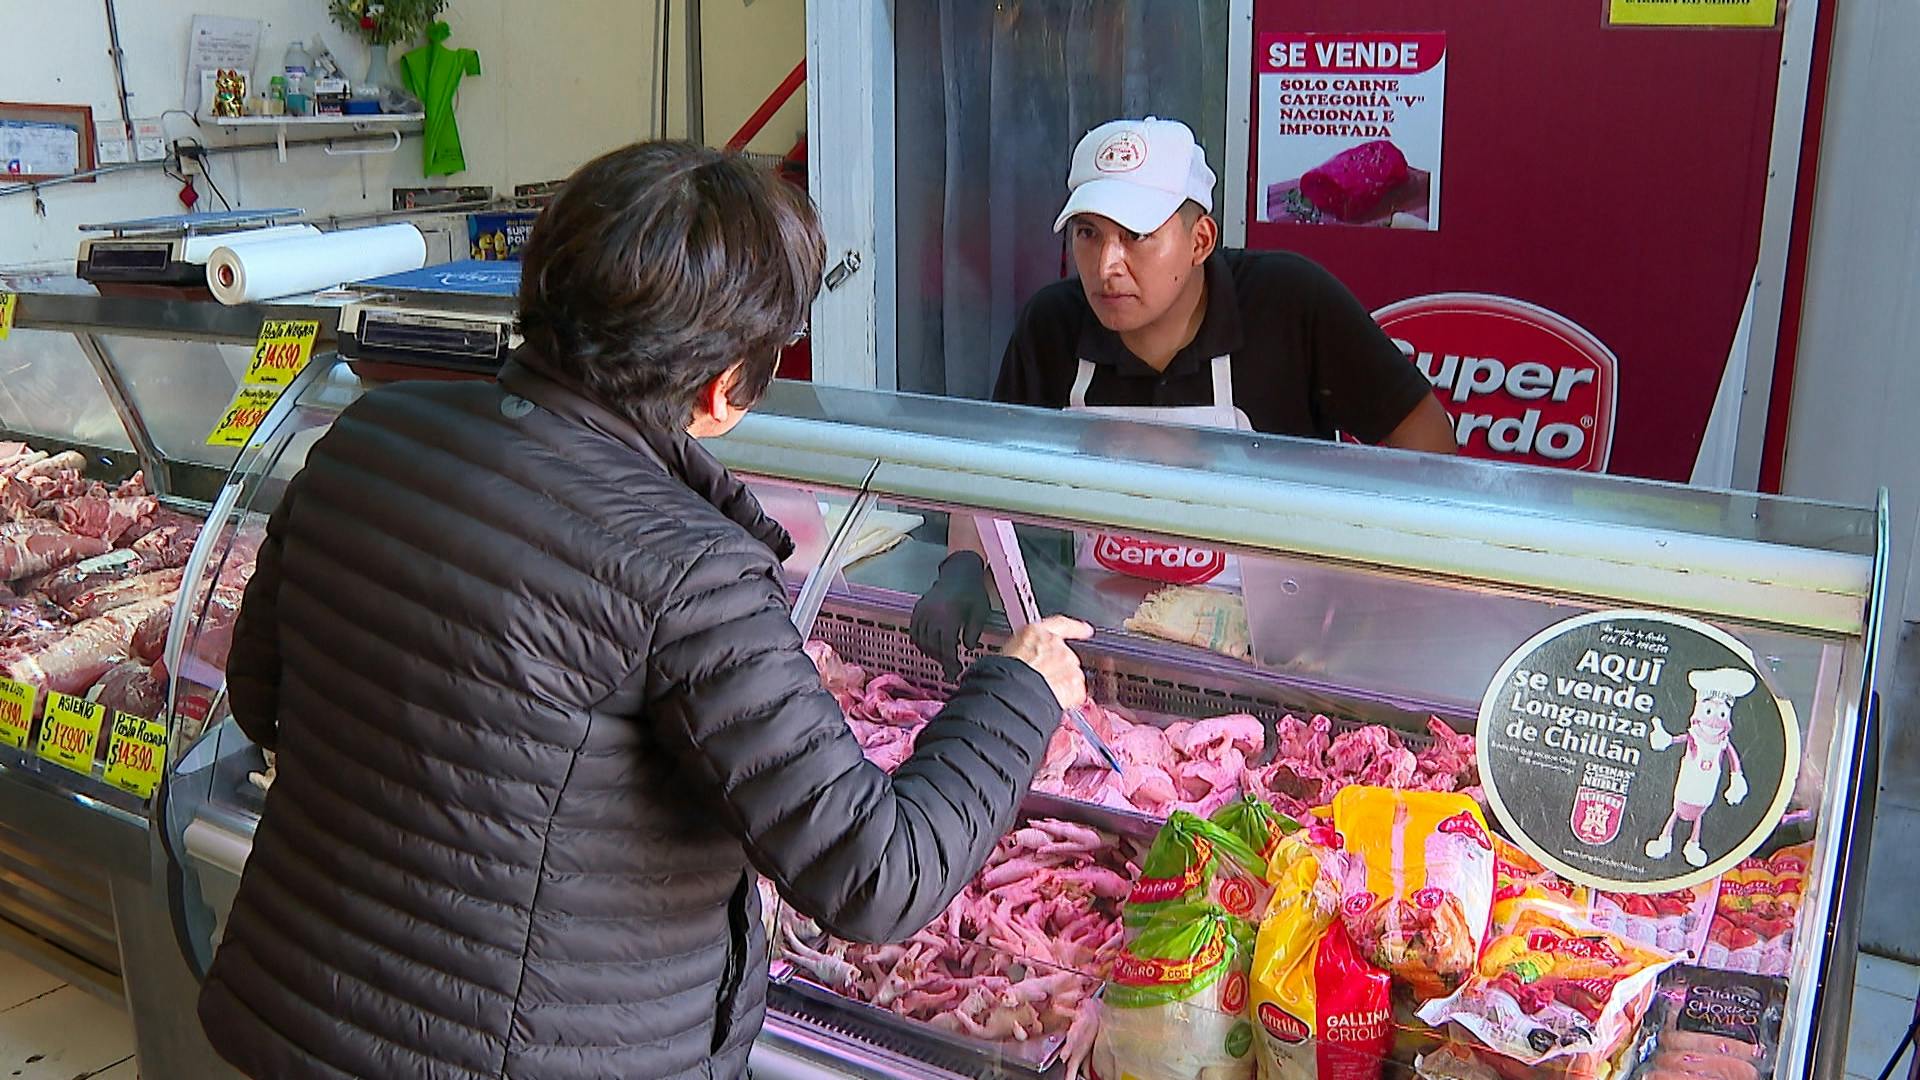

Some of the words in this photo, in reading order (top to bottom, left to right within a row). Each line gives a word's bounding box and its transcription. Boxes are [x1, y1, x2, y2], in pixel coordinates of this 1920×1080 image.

[1269, 42, 1306, 68] SE
[1315, 42, 1419, 68] VENDE
[1280, 80, 1328, 91] SOLO
[1332, 80, 1399, 92] CARNE
[1280, 92, 1390, 107] CATEGORÍA
[1280, 108, 1378, 122] NACIONAL
[1383, 110, 1395, 122] E
[1280, 123, 1391, 137] IMPORTADA
[1100, 538, 1213, 567] Cerdo
[1576, 648, 1666, 685] AQUÍ
[1512, 669, 1549, 691] se
[1556, 676, 1655, 713] vende
[1511, 691, 1648, 738] Longaniza
[1505, 718, 1538, 742] de
[1544, 725, 1641, 766] Chillán
[1327, 1007, 1390, 1027] GALLINA
